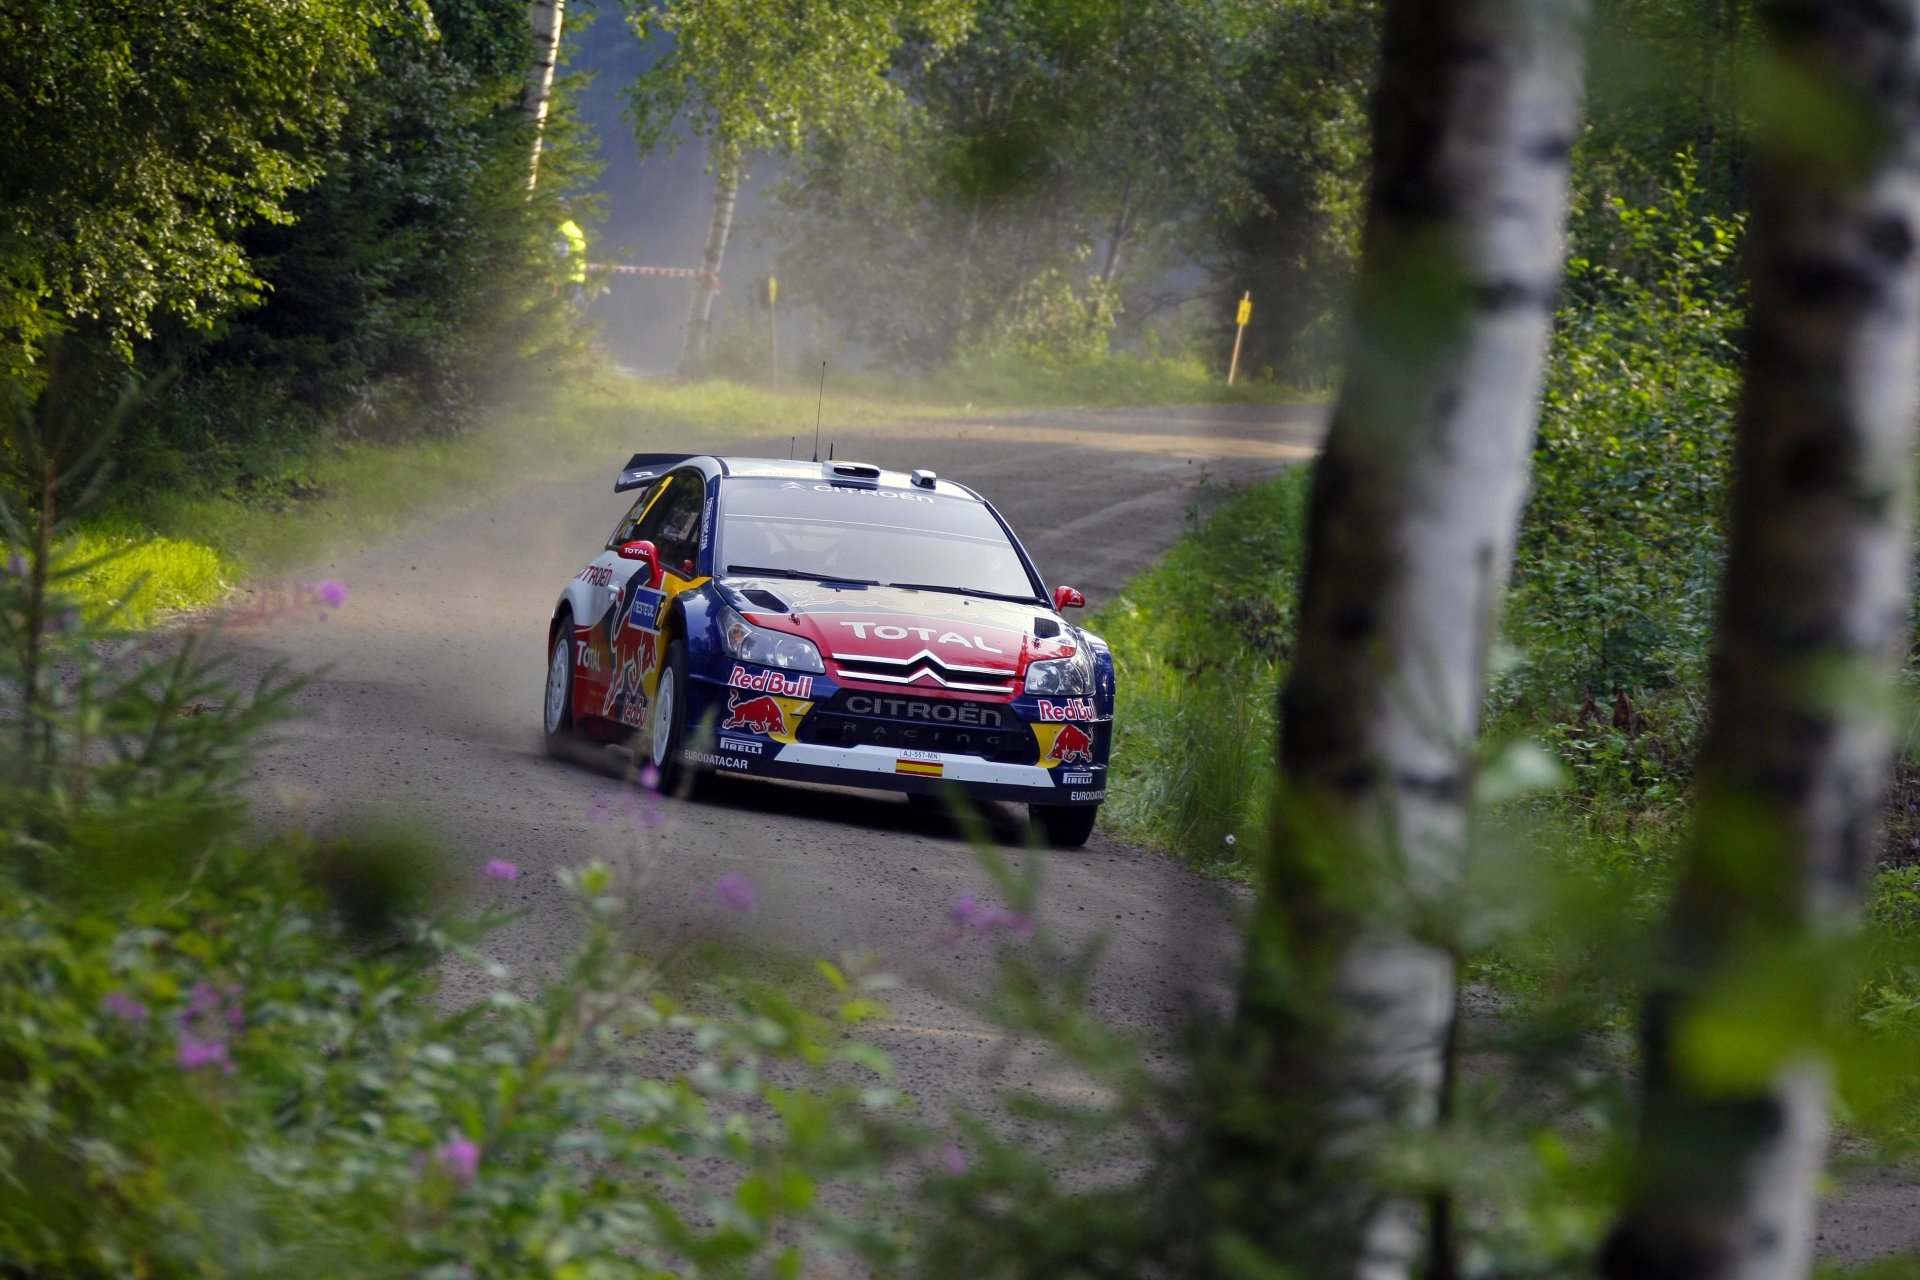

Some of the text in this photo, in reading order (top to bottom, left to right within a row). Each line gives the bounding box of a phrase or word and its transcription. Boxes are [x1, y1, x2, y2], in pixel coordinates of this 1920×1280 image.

[624, 547, 650, 556] TOTAL
[840, 621, 1003, 654] TOTAL
[576, 640, 601, 672] TOTAL
[728, 666, 814, 699] Red Bull
[1038, 698, 1078, 721] Red
[720, 737, 763, 754] PIRELLI
[903, 750, 938, 759] AJ-557-MN
[684, 750, 749, 770] EURODATACAR
[1062, 772, 1093, 784] PIRELLI
